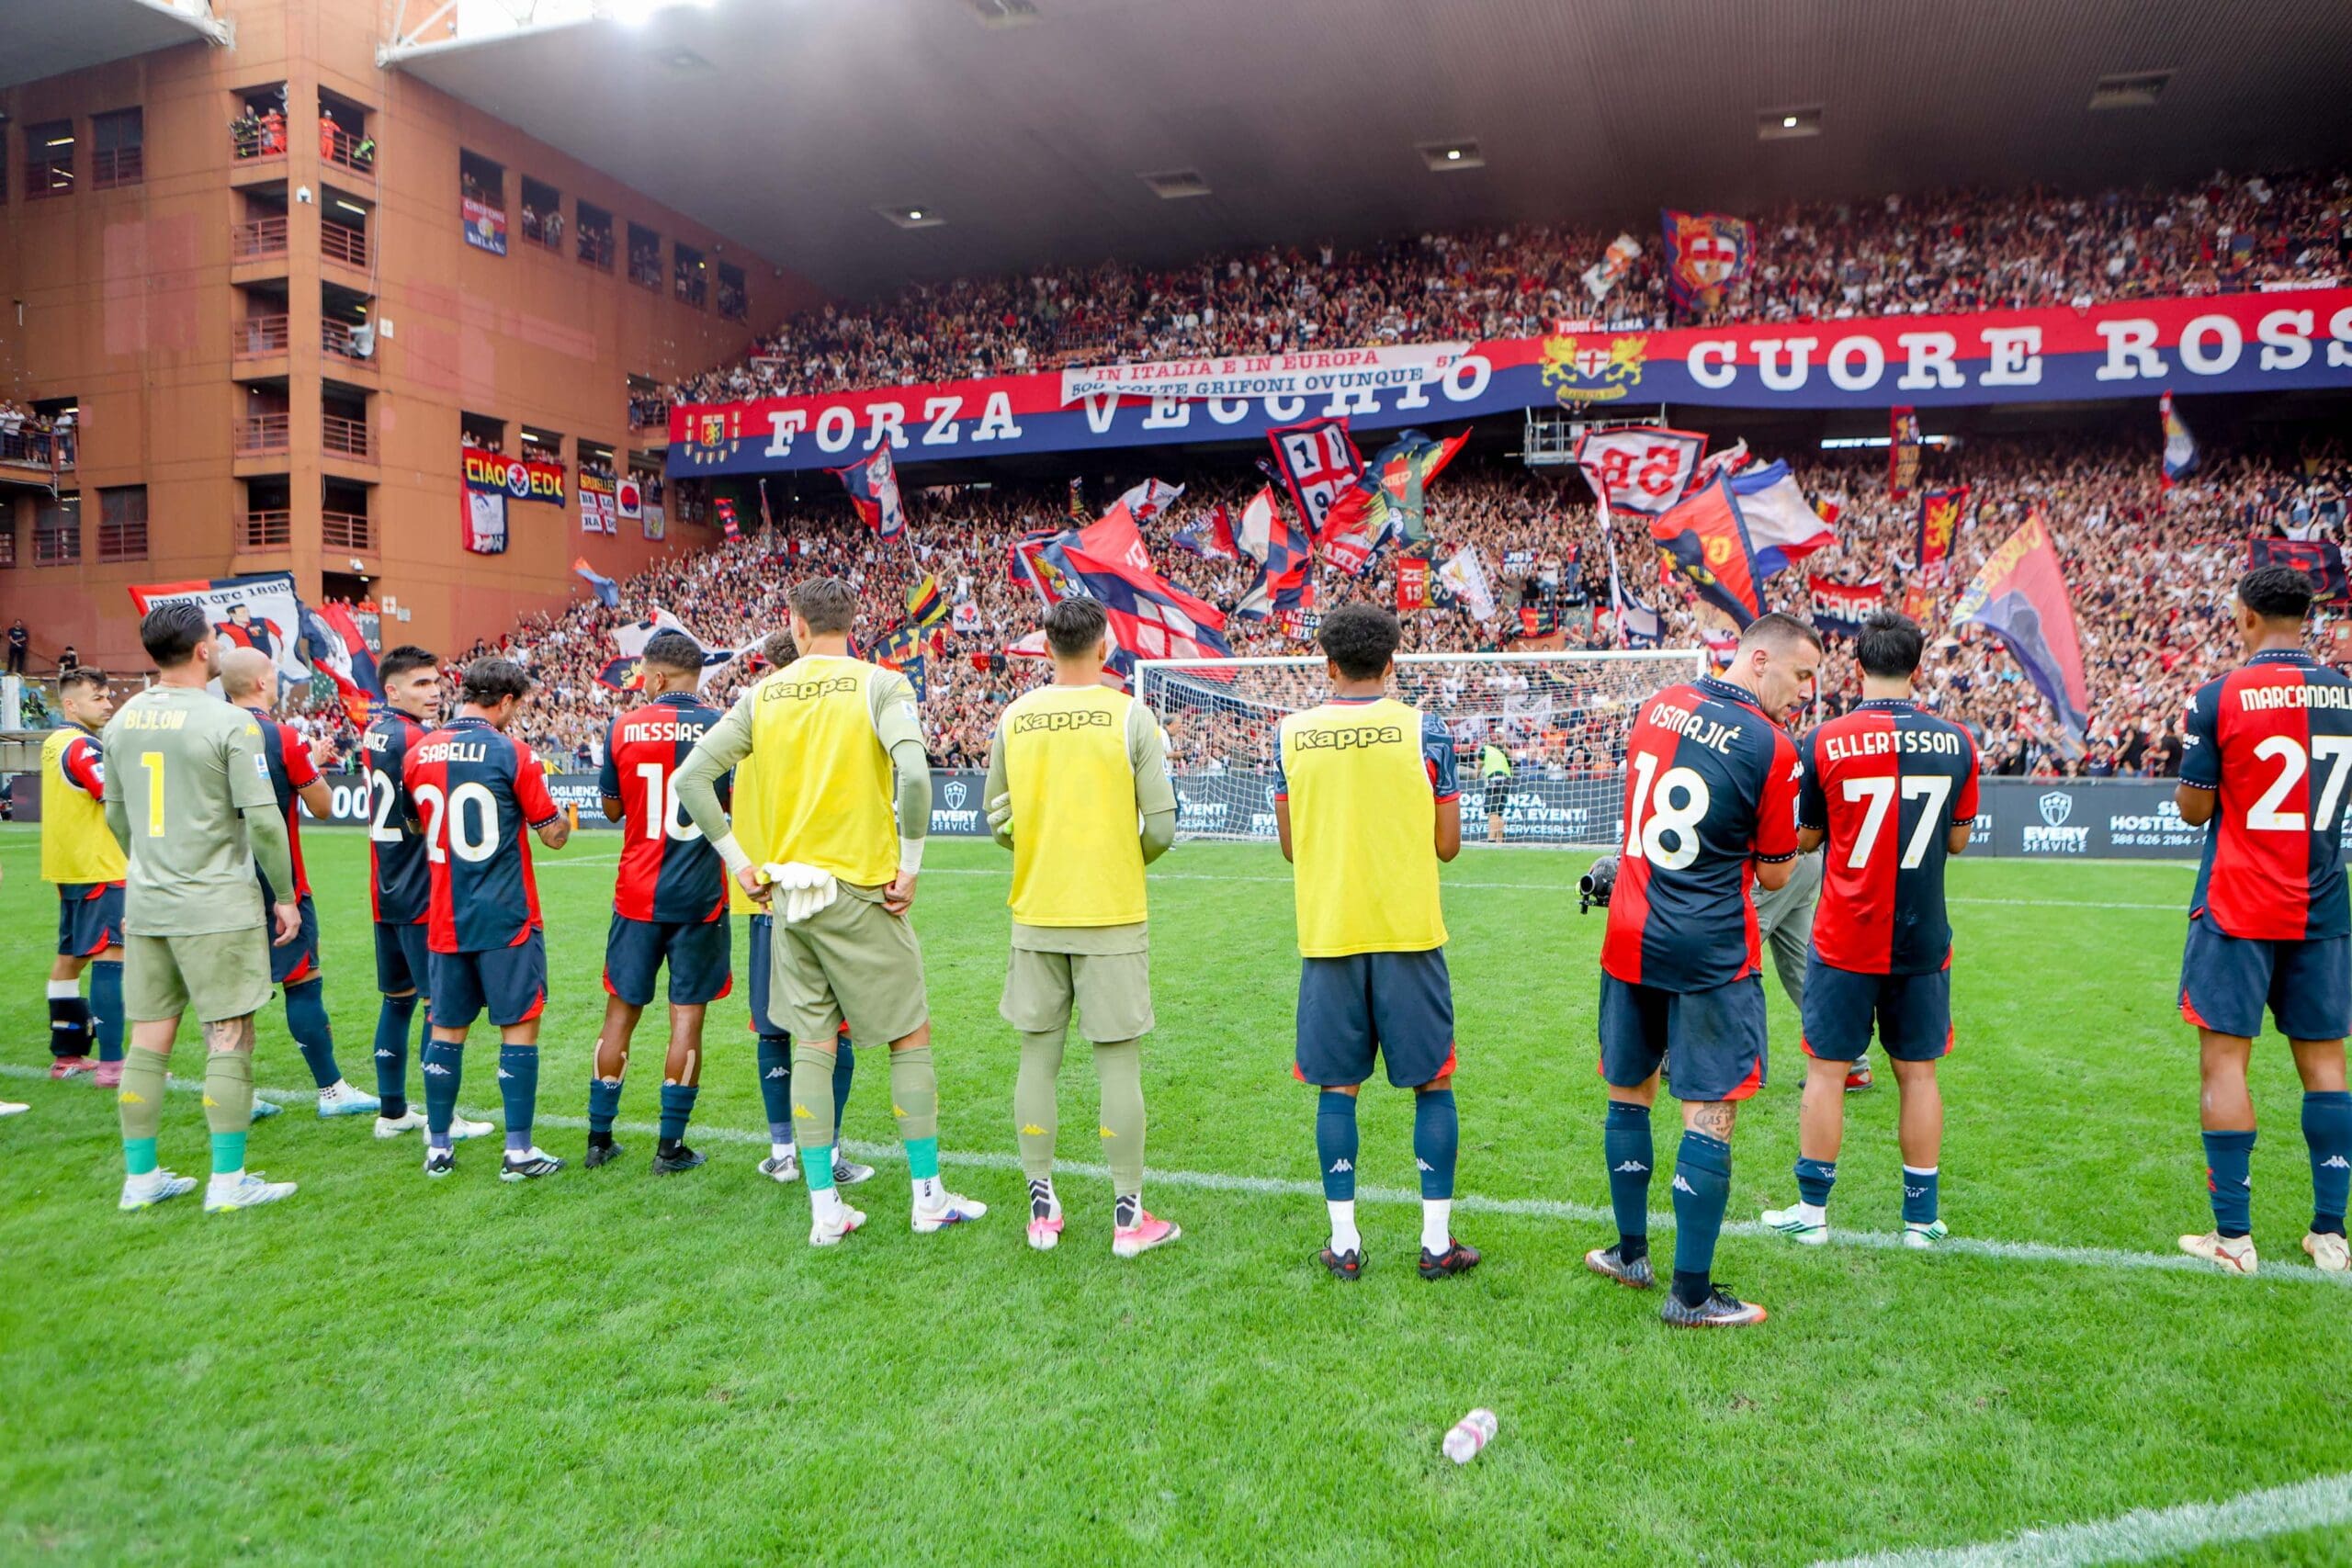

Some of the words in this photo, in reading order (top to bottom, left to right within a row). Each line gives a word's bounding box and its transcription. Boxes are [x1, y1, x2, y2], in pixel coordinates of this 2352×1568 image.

[1096, 367, 1121, 380] IN
[1131, 359, 1214, 379] ITALIA
[1222, 360, 1236, 374] E
[1245, 359, 1272, 372] IN
[1282, 350, 1379, 370] EUROPA
[763, 391, 1022, 457] FORZA
[1687, 326, 2042, 391] CUORE
[1196, 378, 1295, 395] GRIFONI
[1306, 367, 1422, 390] OVUNQUE
[466, 457, 506, 487] CIAO
[210, 591, 243, 604] CFC
[763, 677, 857, 702] Kappa
[124, 710, 187, 729] BIJLOW
[1014, 710, 1112, 734] Kappa
[1649, 703, 1741, 755] OSMAJIĆ
[624, 723, 704, 742] MESSIAS
[1295, 727, 1402, 751] Kappa
[418, 743, 486, 764] SABELLI
[1825, 730, 1960, 761] ELLERTSSON
[141, 751, 164, 838] 1
[2245, 735, 2352, 831] 27
[413, 782, 500, 863] 20
[932, 810, 978, 821] EVERY
[1527, 808, 1588, 822] EVENTI
[1625, 750, 1710, 871] 18
[1842, 775, 1952, 869] 77
[932, 821, 977, 831] SERVICE
[2023, 827, 2090, 840] EVERY
[2022, 840, 2087, 852] SERVICE
